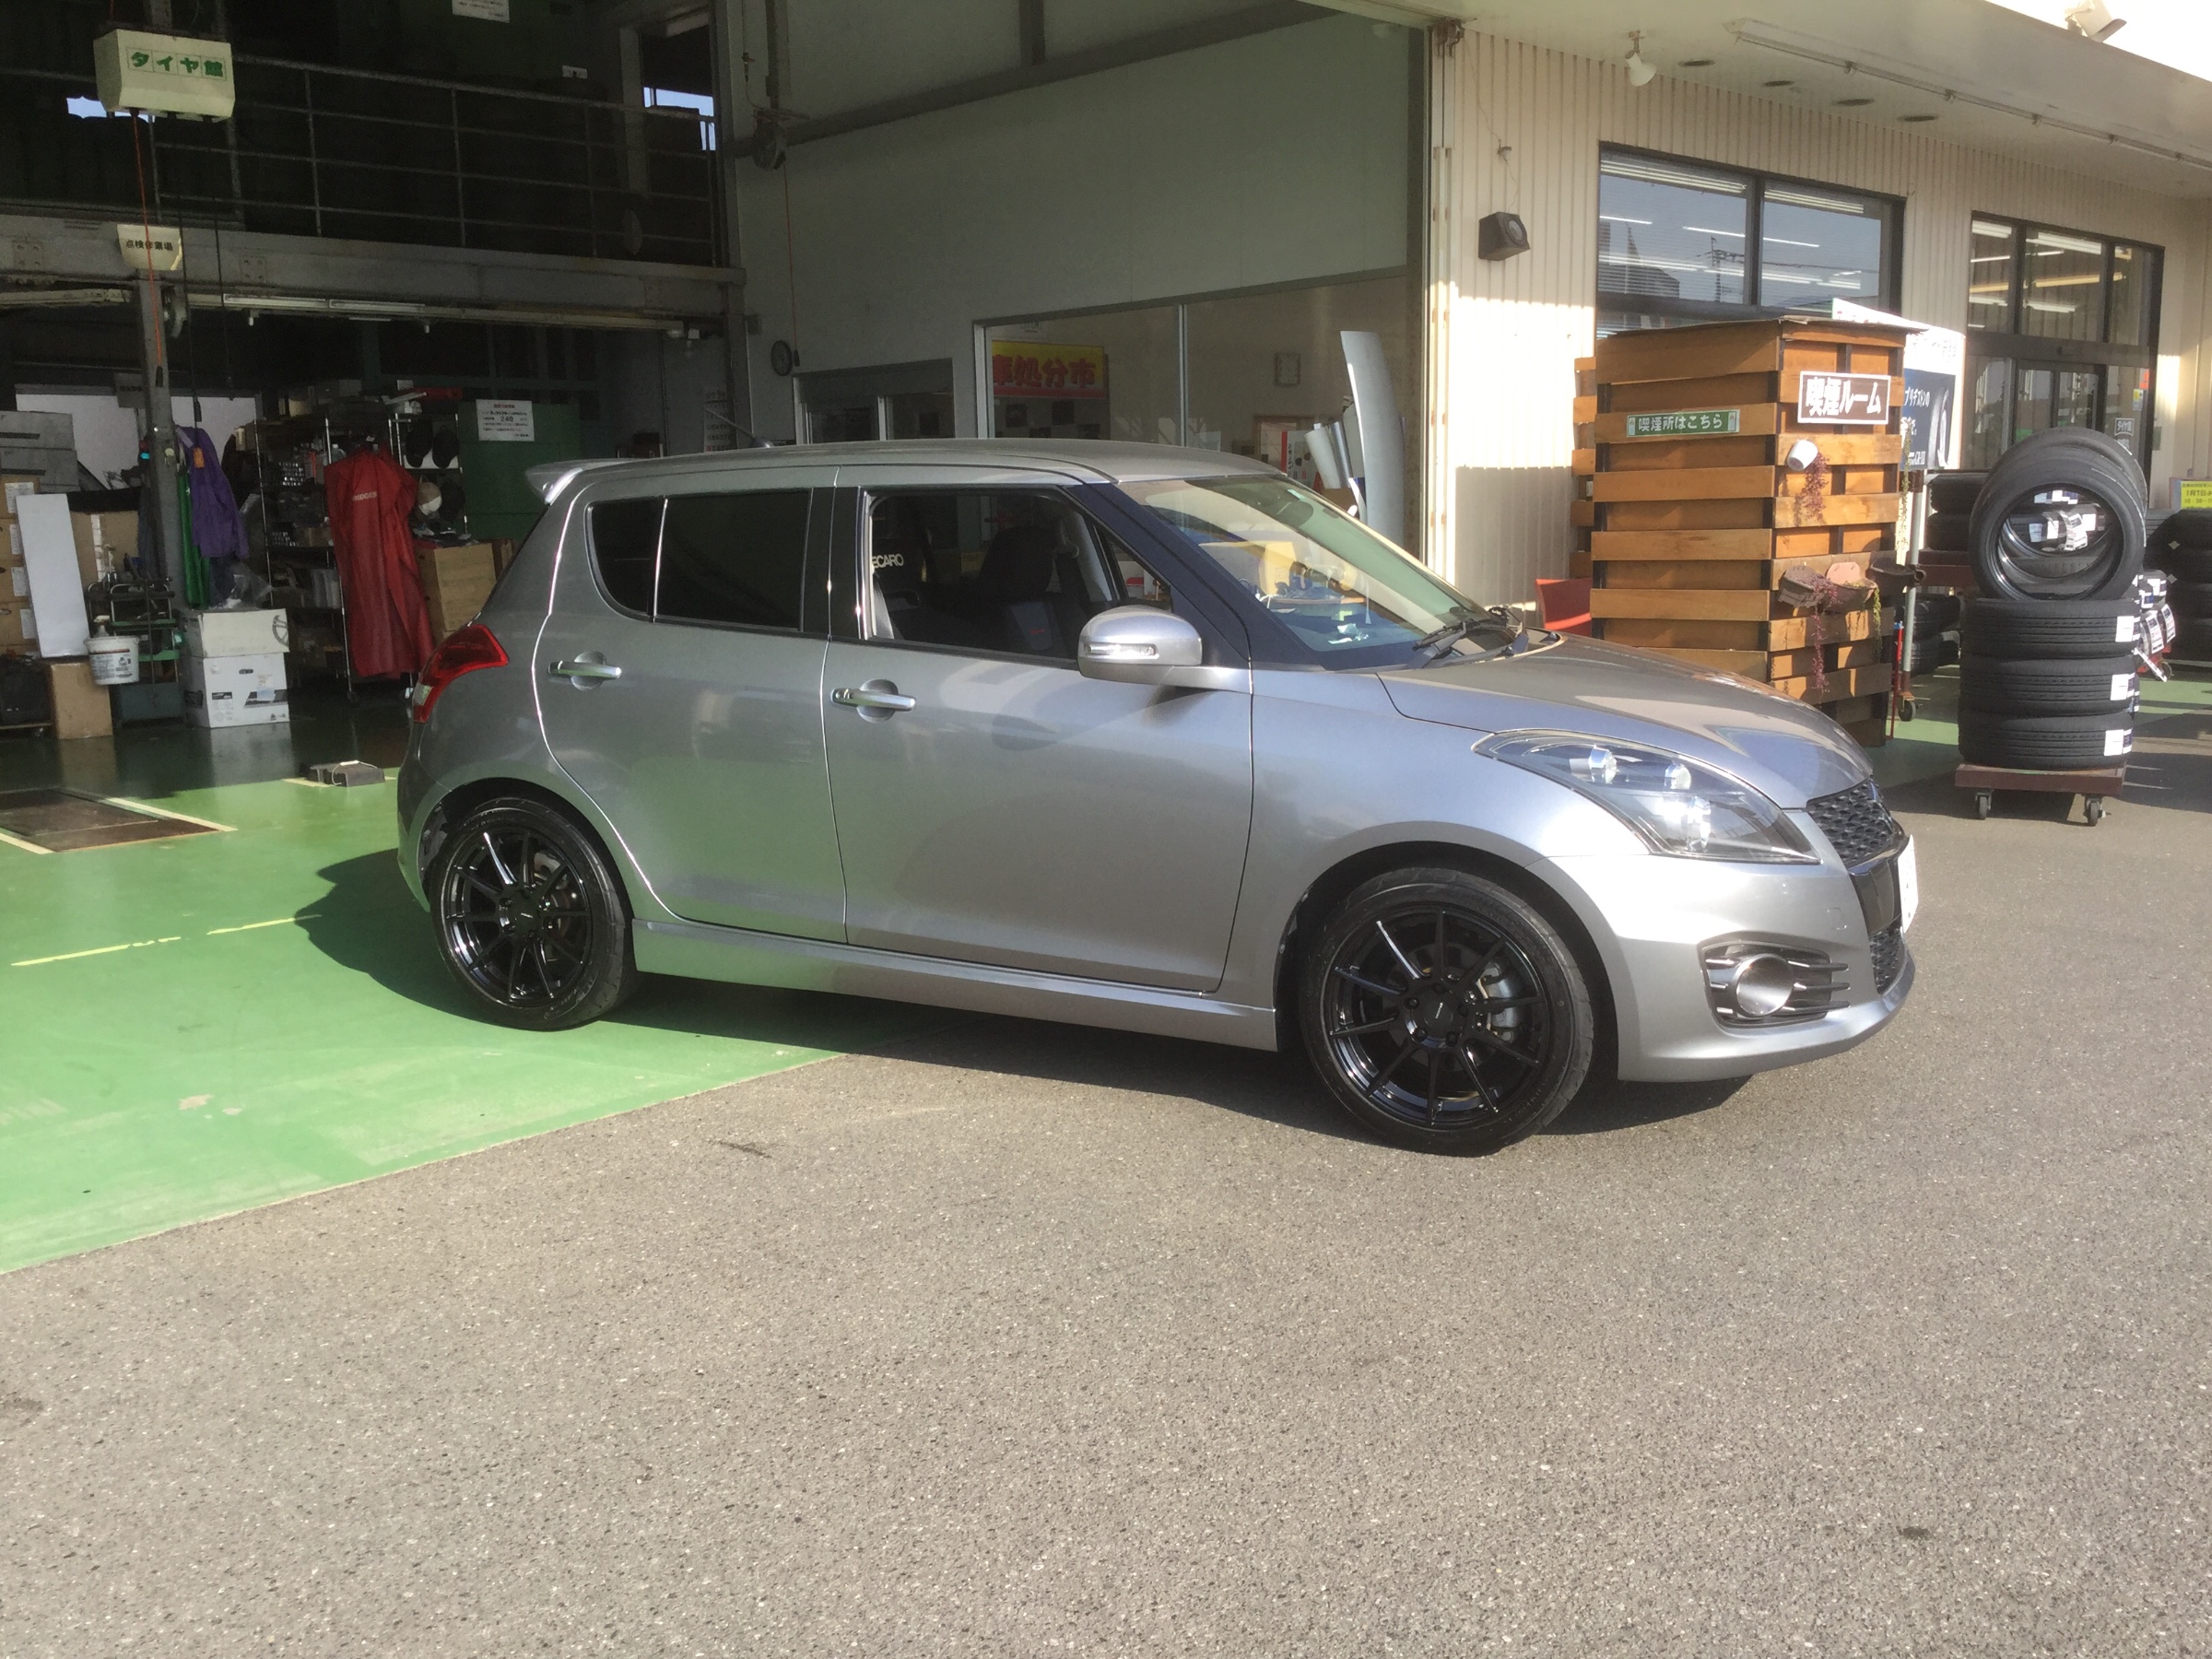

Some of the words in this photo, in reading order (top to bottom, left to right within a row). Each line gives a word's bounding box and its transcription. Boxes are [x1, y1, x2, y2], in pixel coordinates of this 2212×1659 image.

[130, 52, 224, 77] タイヤ館
[1806, 376, 1882, 417] 喫煙ルーム
[1638, 413, 1723, 432] 喫煙所はこちら
